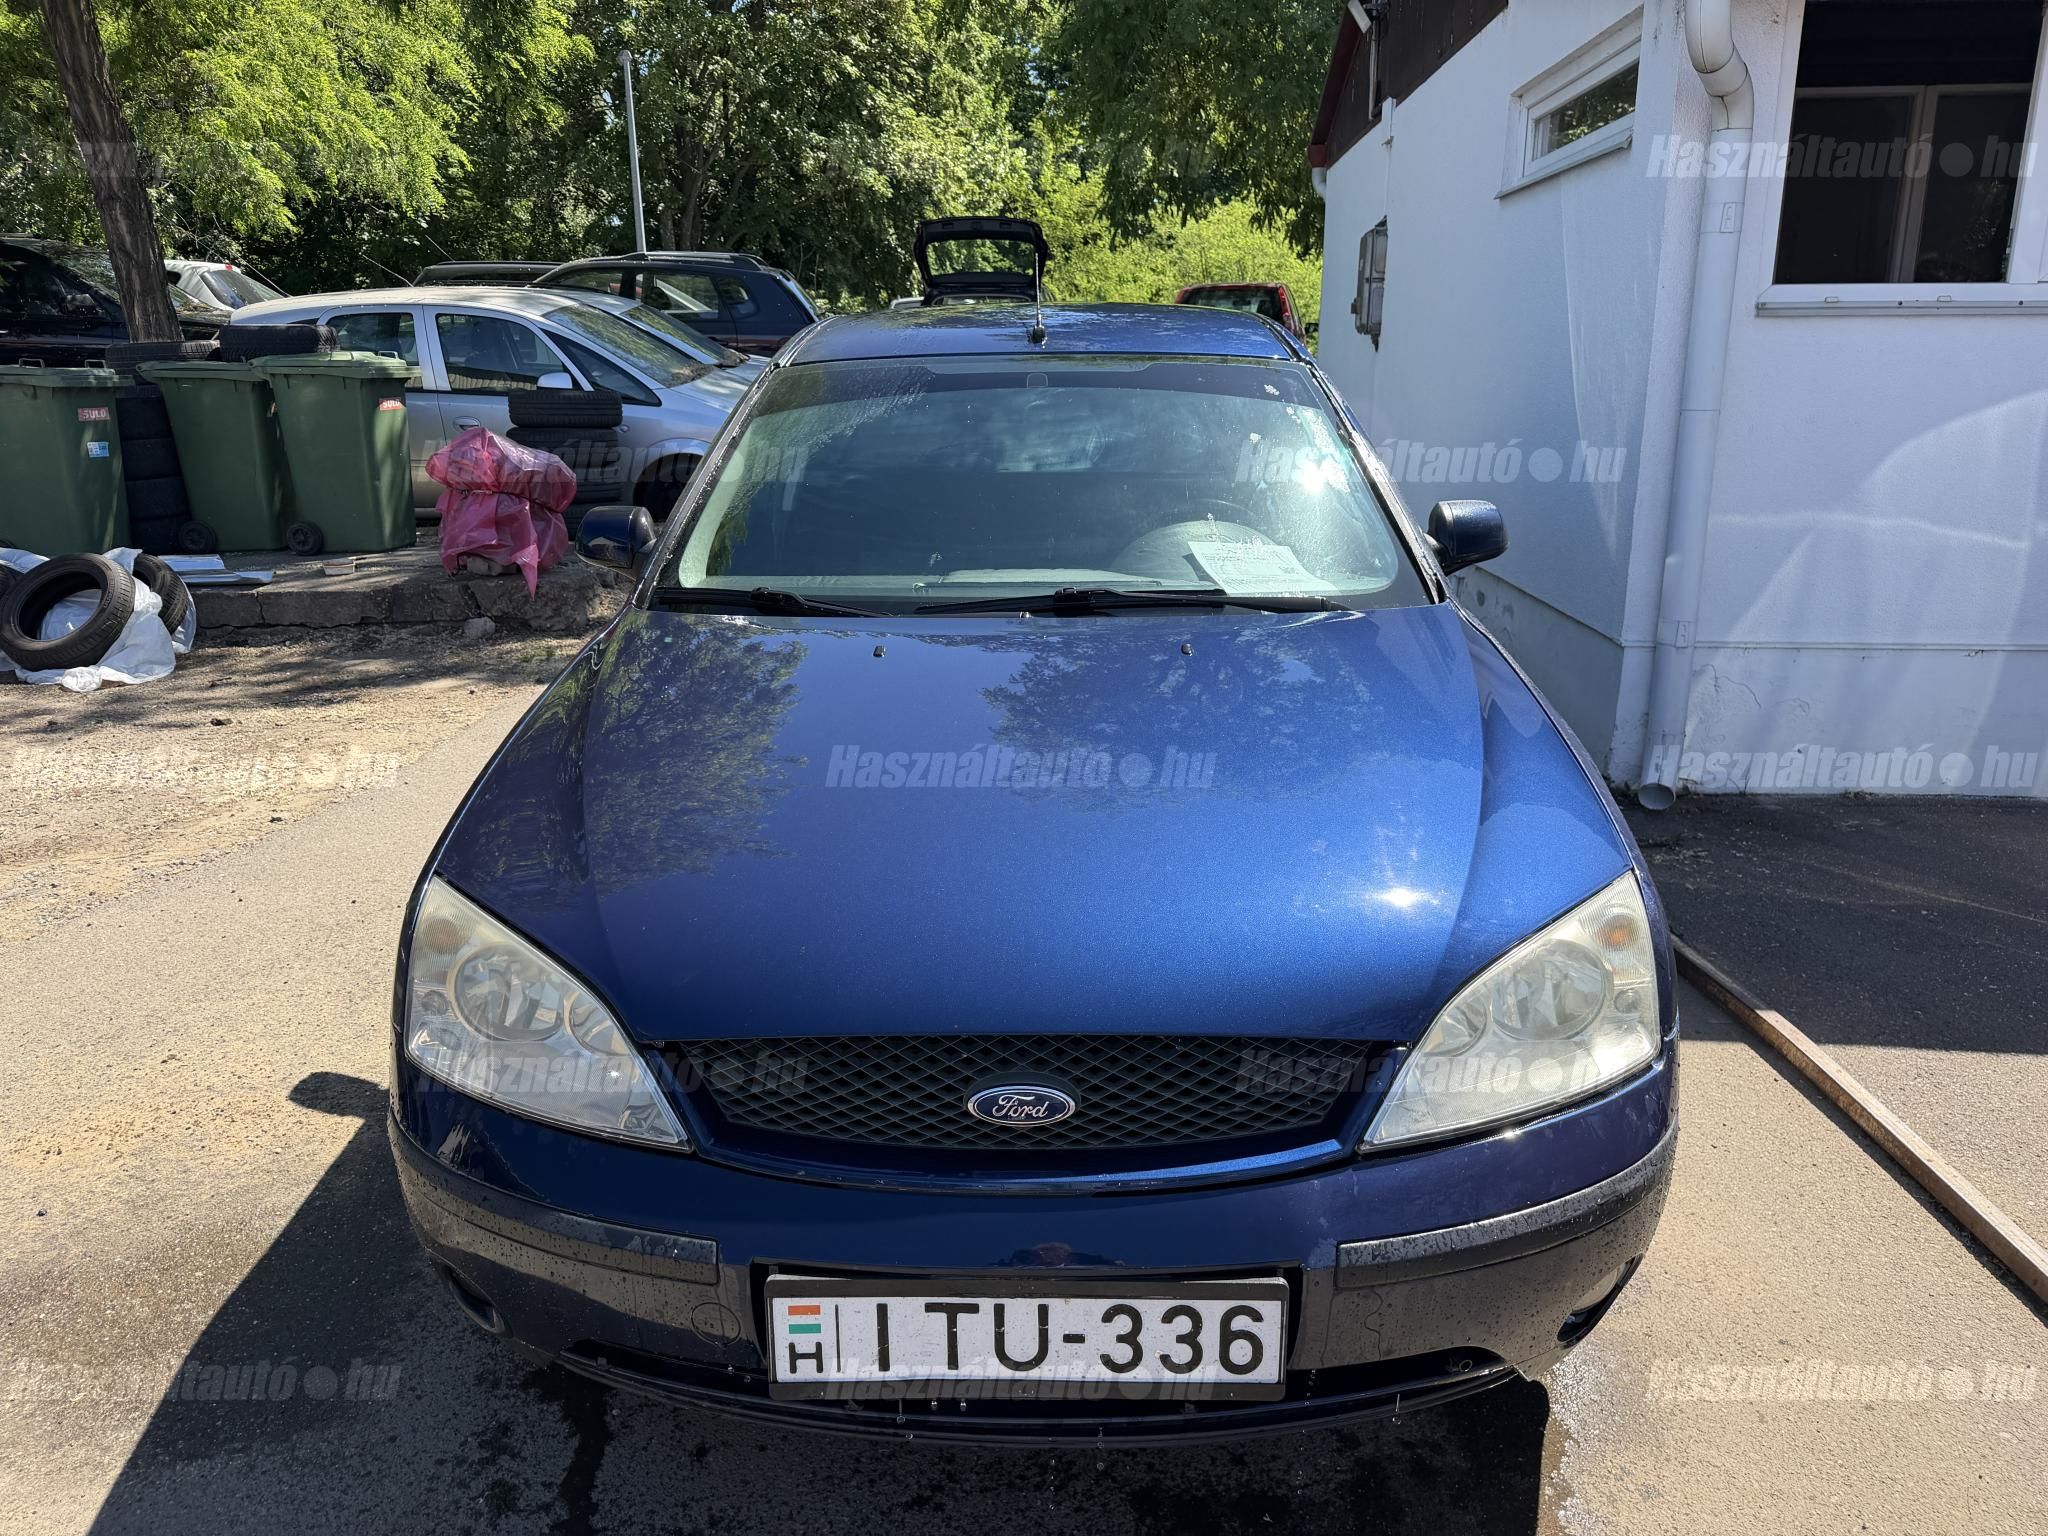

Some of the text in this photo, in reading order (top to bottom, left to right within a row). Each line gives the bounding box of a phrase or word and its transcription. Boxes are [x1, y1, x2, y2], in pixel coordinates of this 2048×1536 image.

[83, 409, 106, 419] SULO
[992, 1095, 1050, 1117] Ford
[876, 1302, 1264, 1375] ITU-336
[788, 1341, 823, 1374] H
